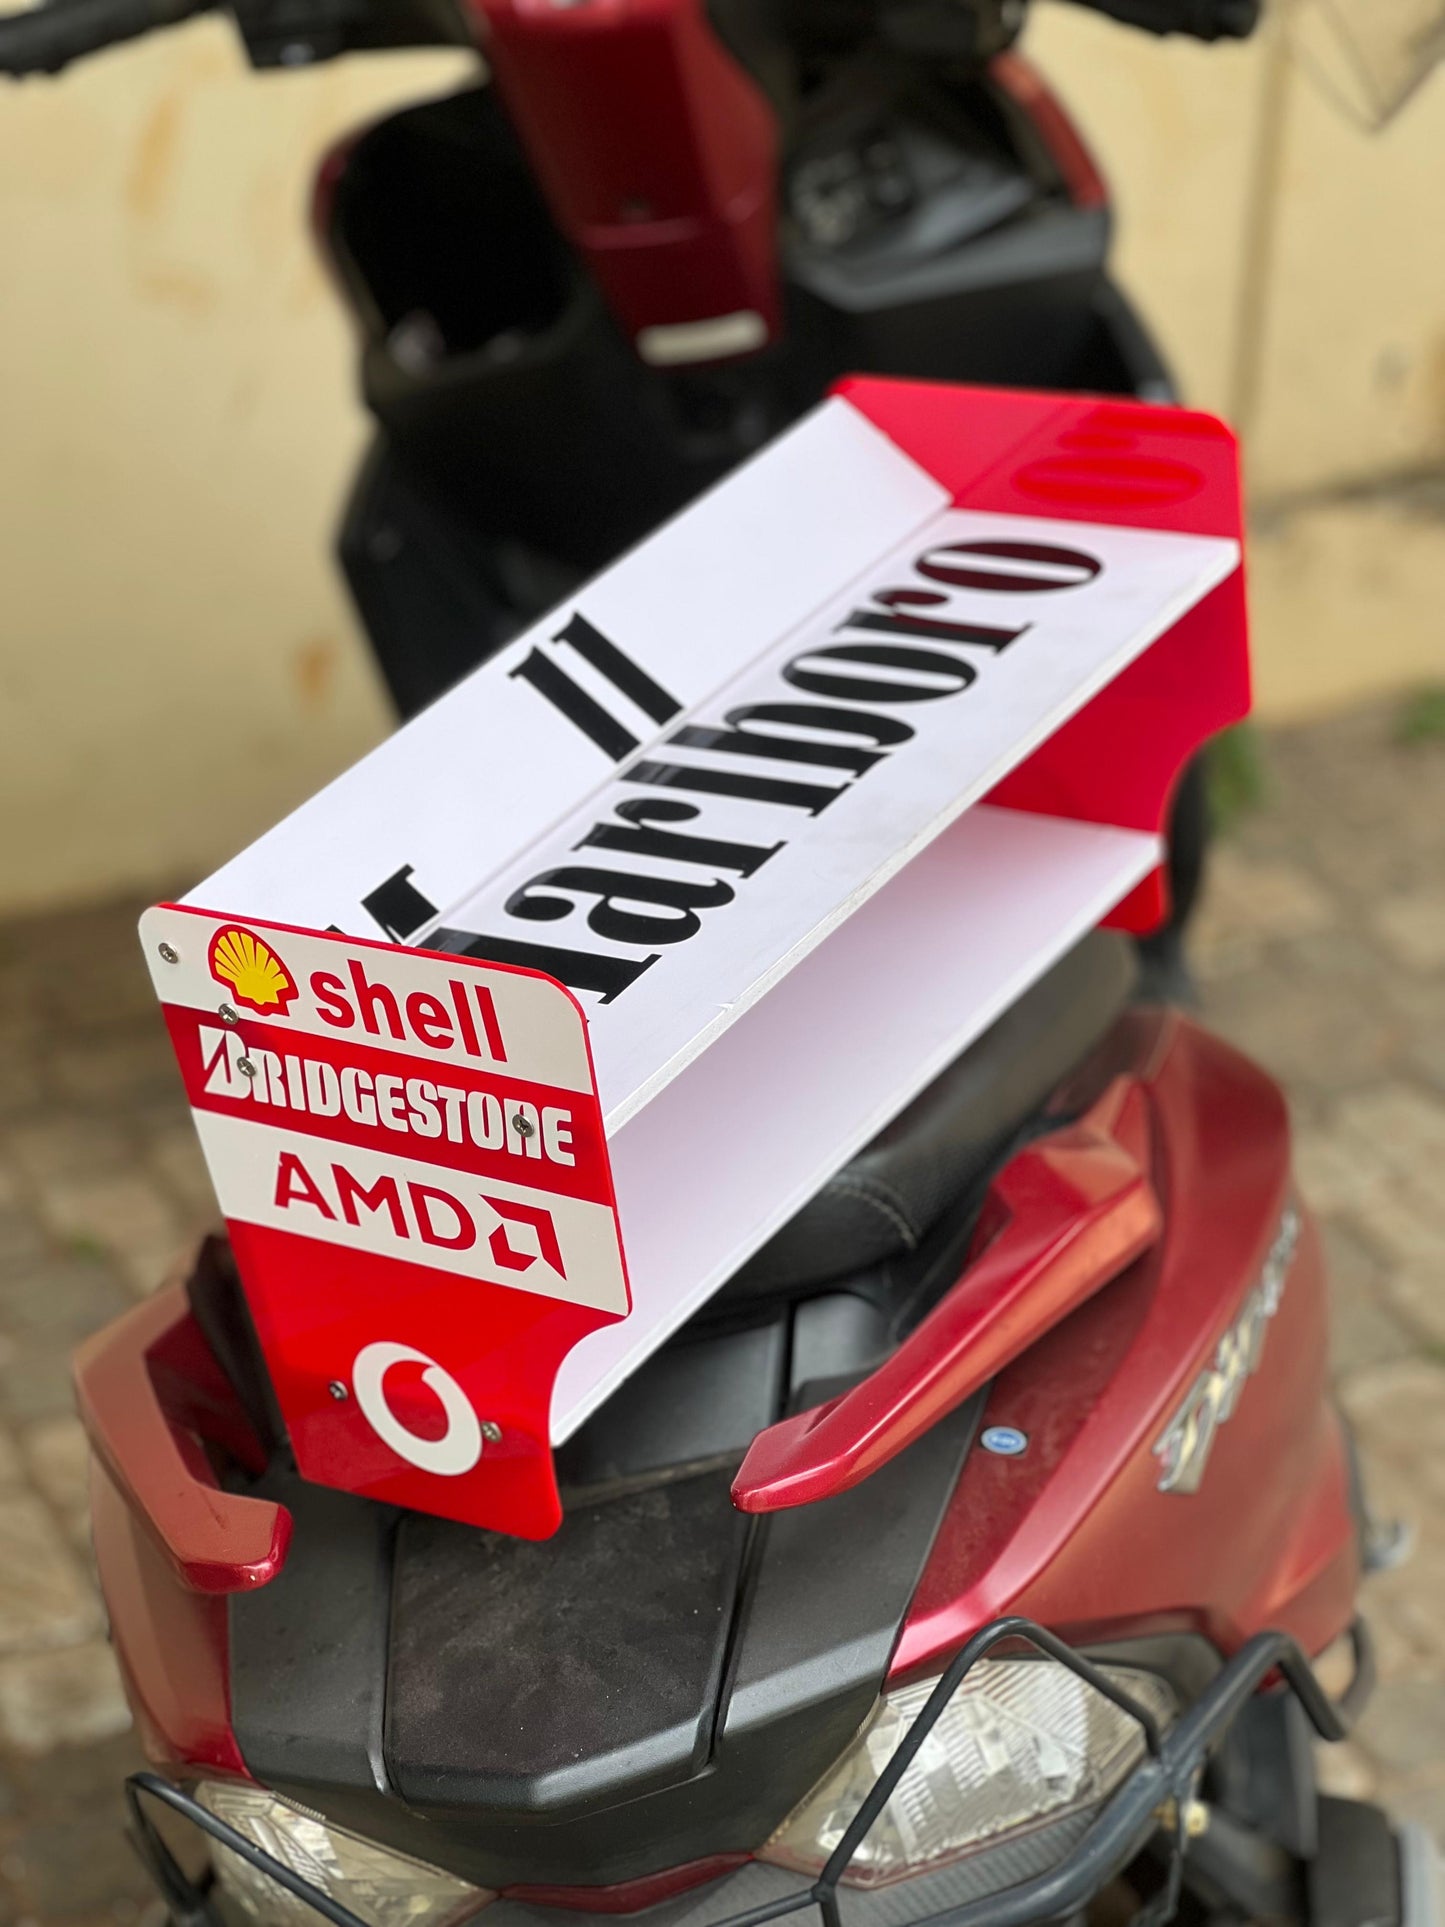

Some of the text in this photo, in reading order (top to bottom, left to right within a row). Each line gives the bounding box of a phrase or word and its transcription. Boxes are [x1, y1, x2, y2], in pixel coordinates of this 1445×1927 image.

[309, 958, 508, 1063] shell
[199, 1023, 577, 1167] BRIDGESTONE
[274, 1150, 477, 1251] AMD
